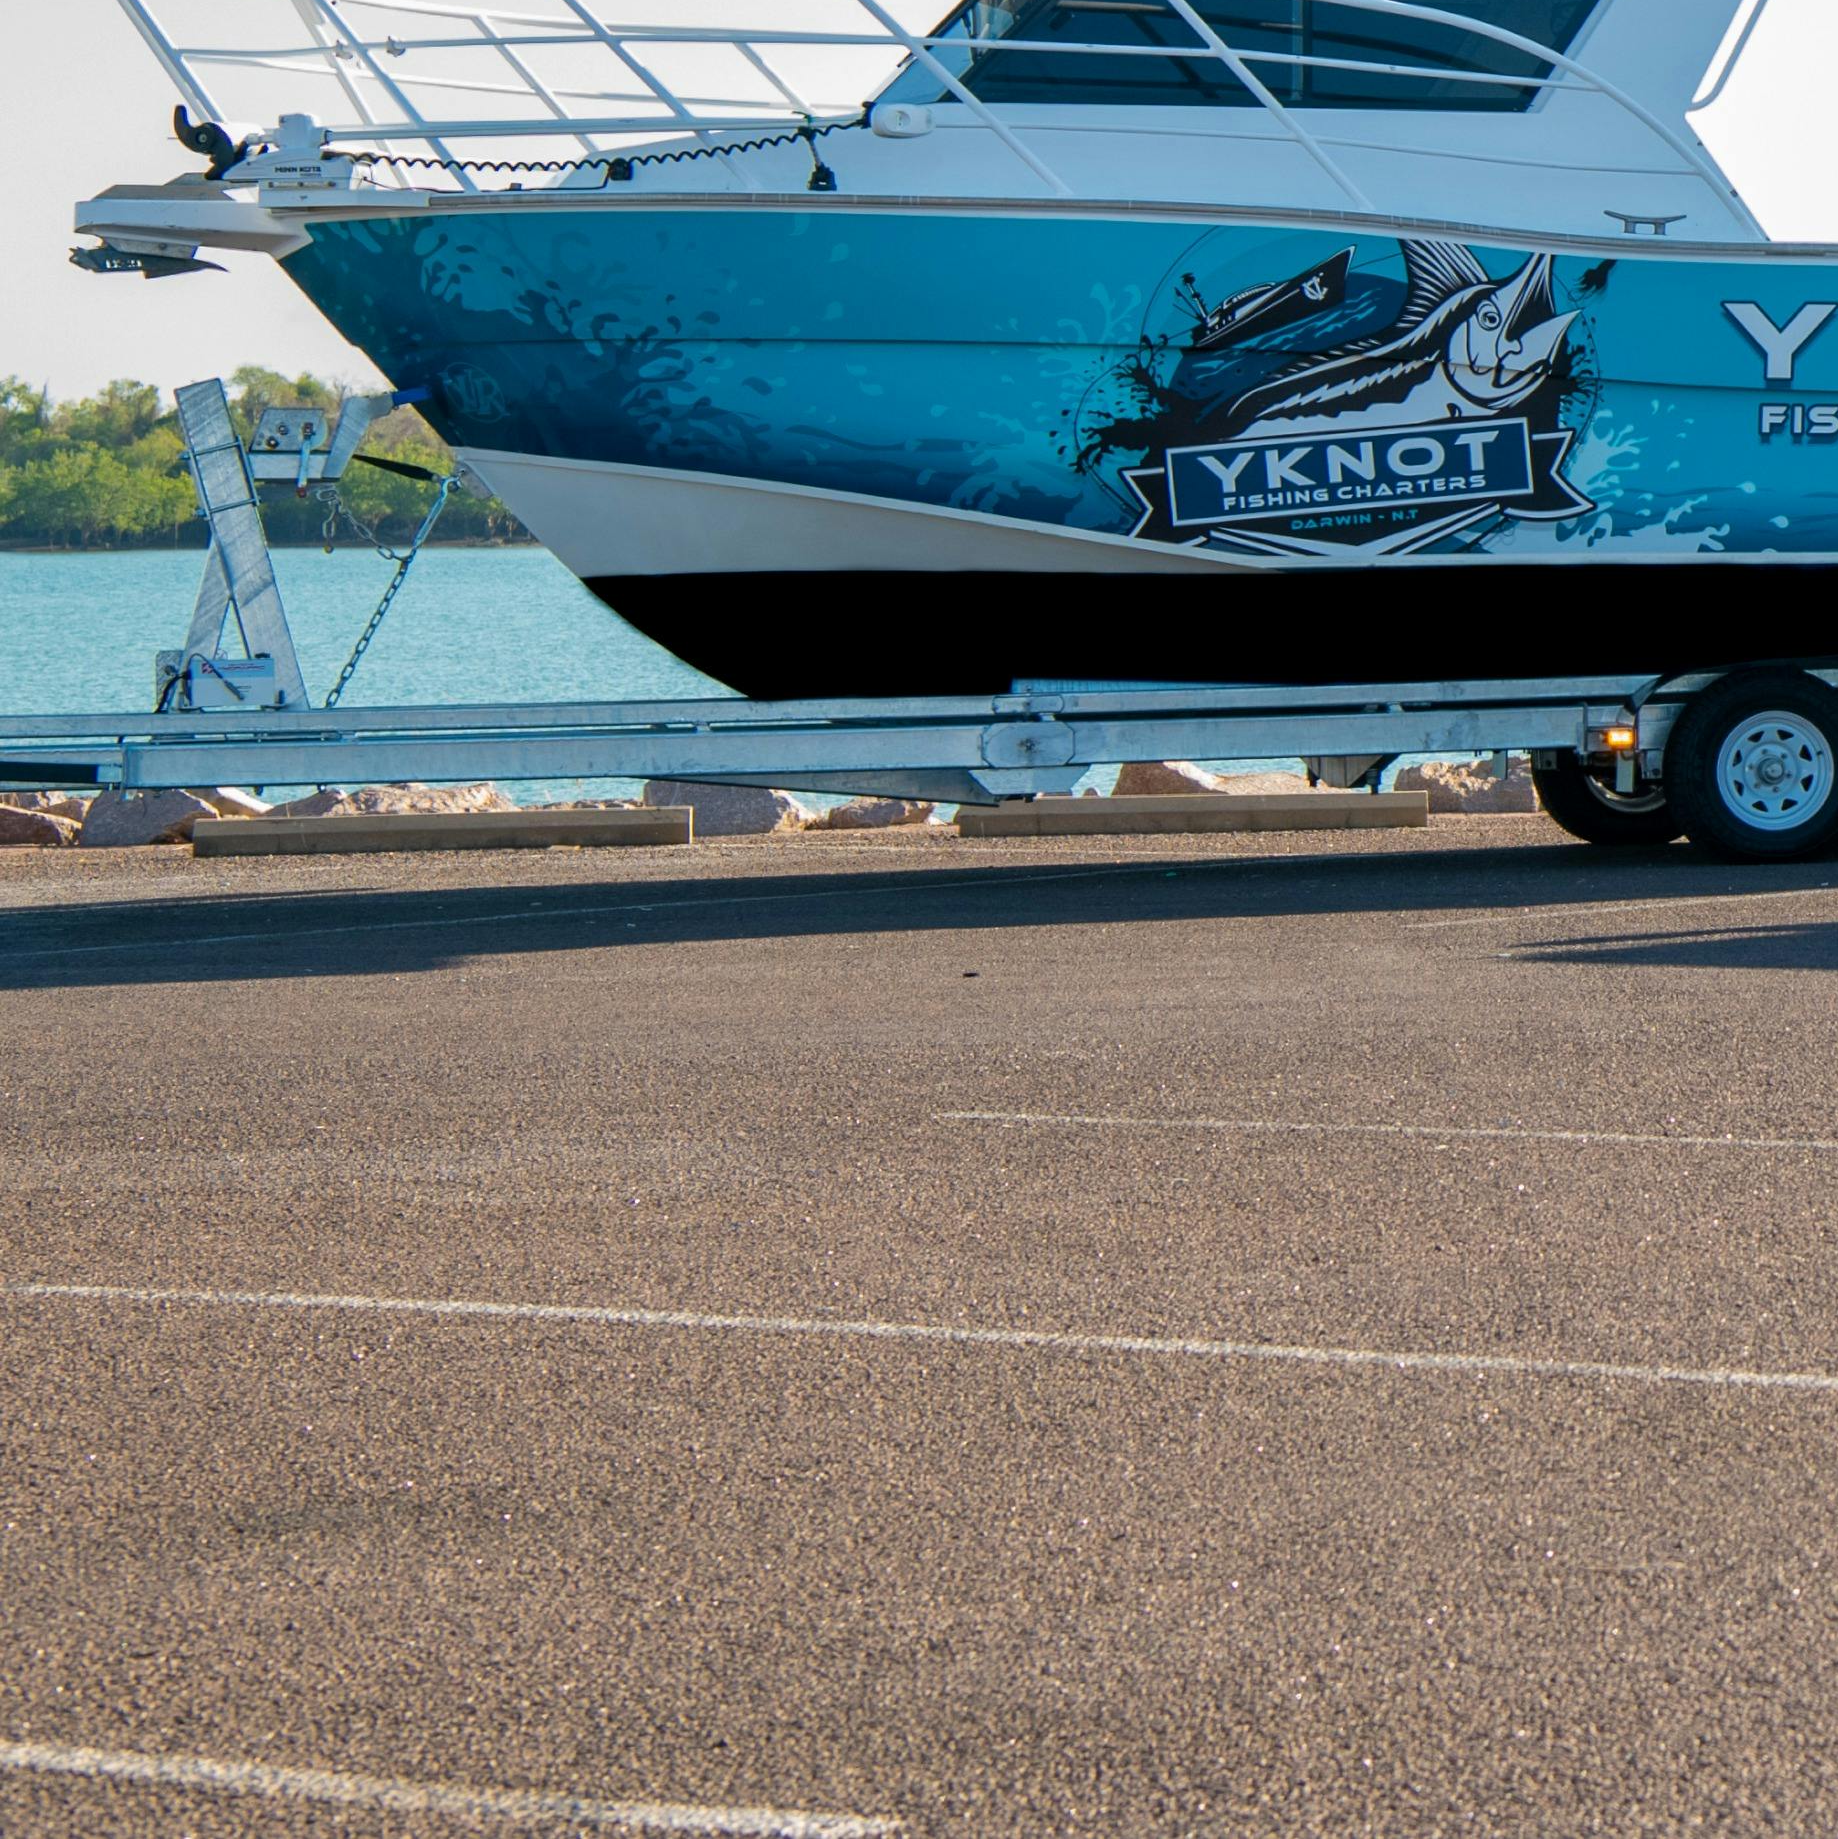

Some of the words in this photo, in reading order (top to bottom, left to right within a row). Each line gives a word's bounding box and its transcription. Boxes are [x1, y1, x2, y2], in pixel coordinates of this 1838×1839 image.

[1197, 430, 1499, 493] YKNOT
[1223, 488, 1329, 510] FISHING
[1337, 475, 1487, 499] CHARTERS
[1291, 514, 1372, 531] DARWIN
